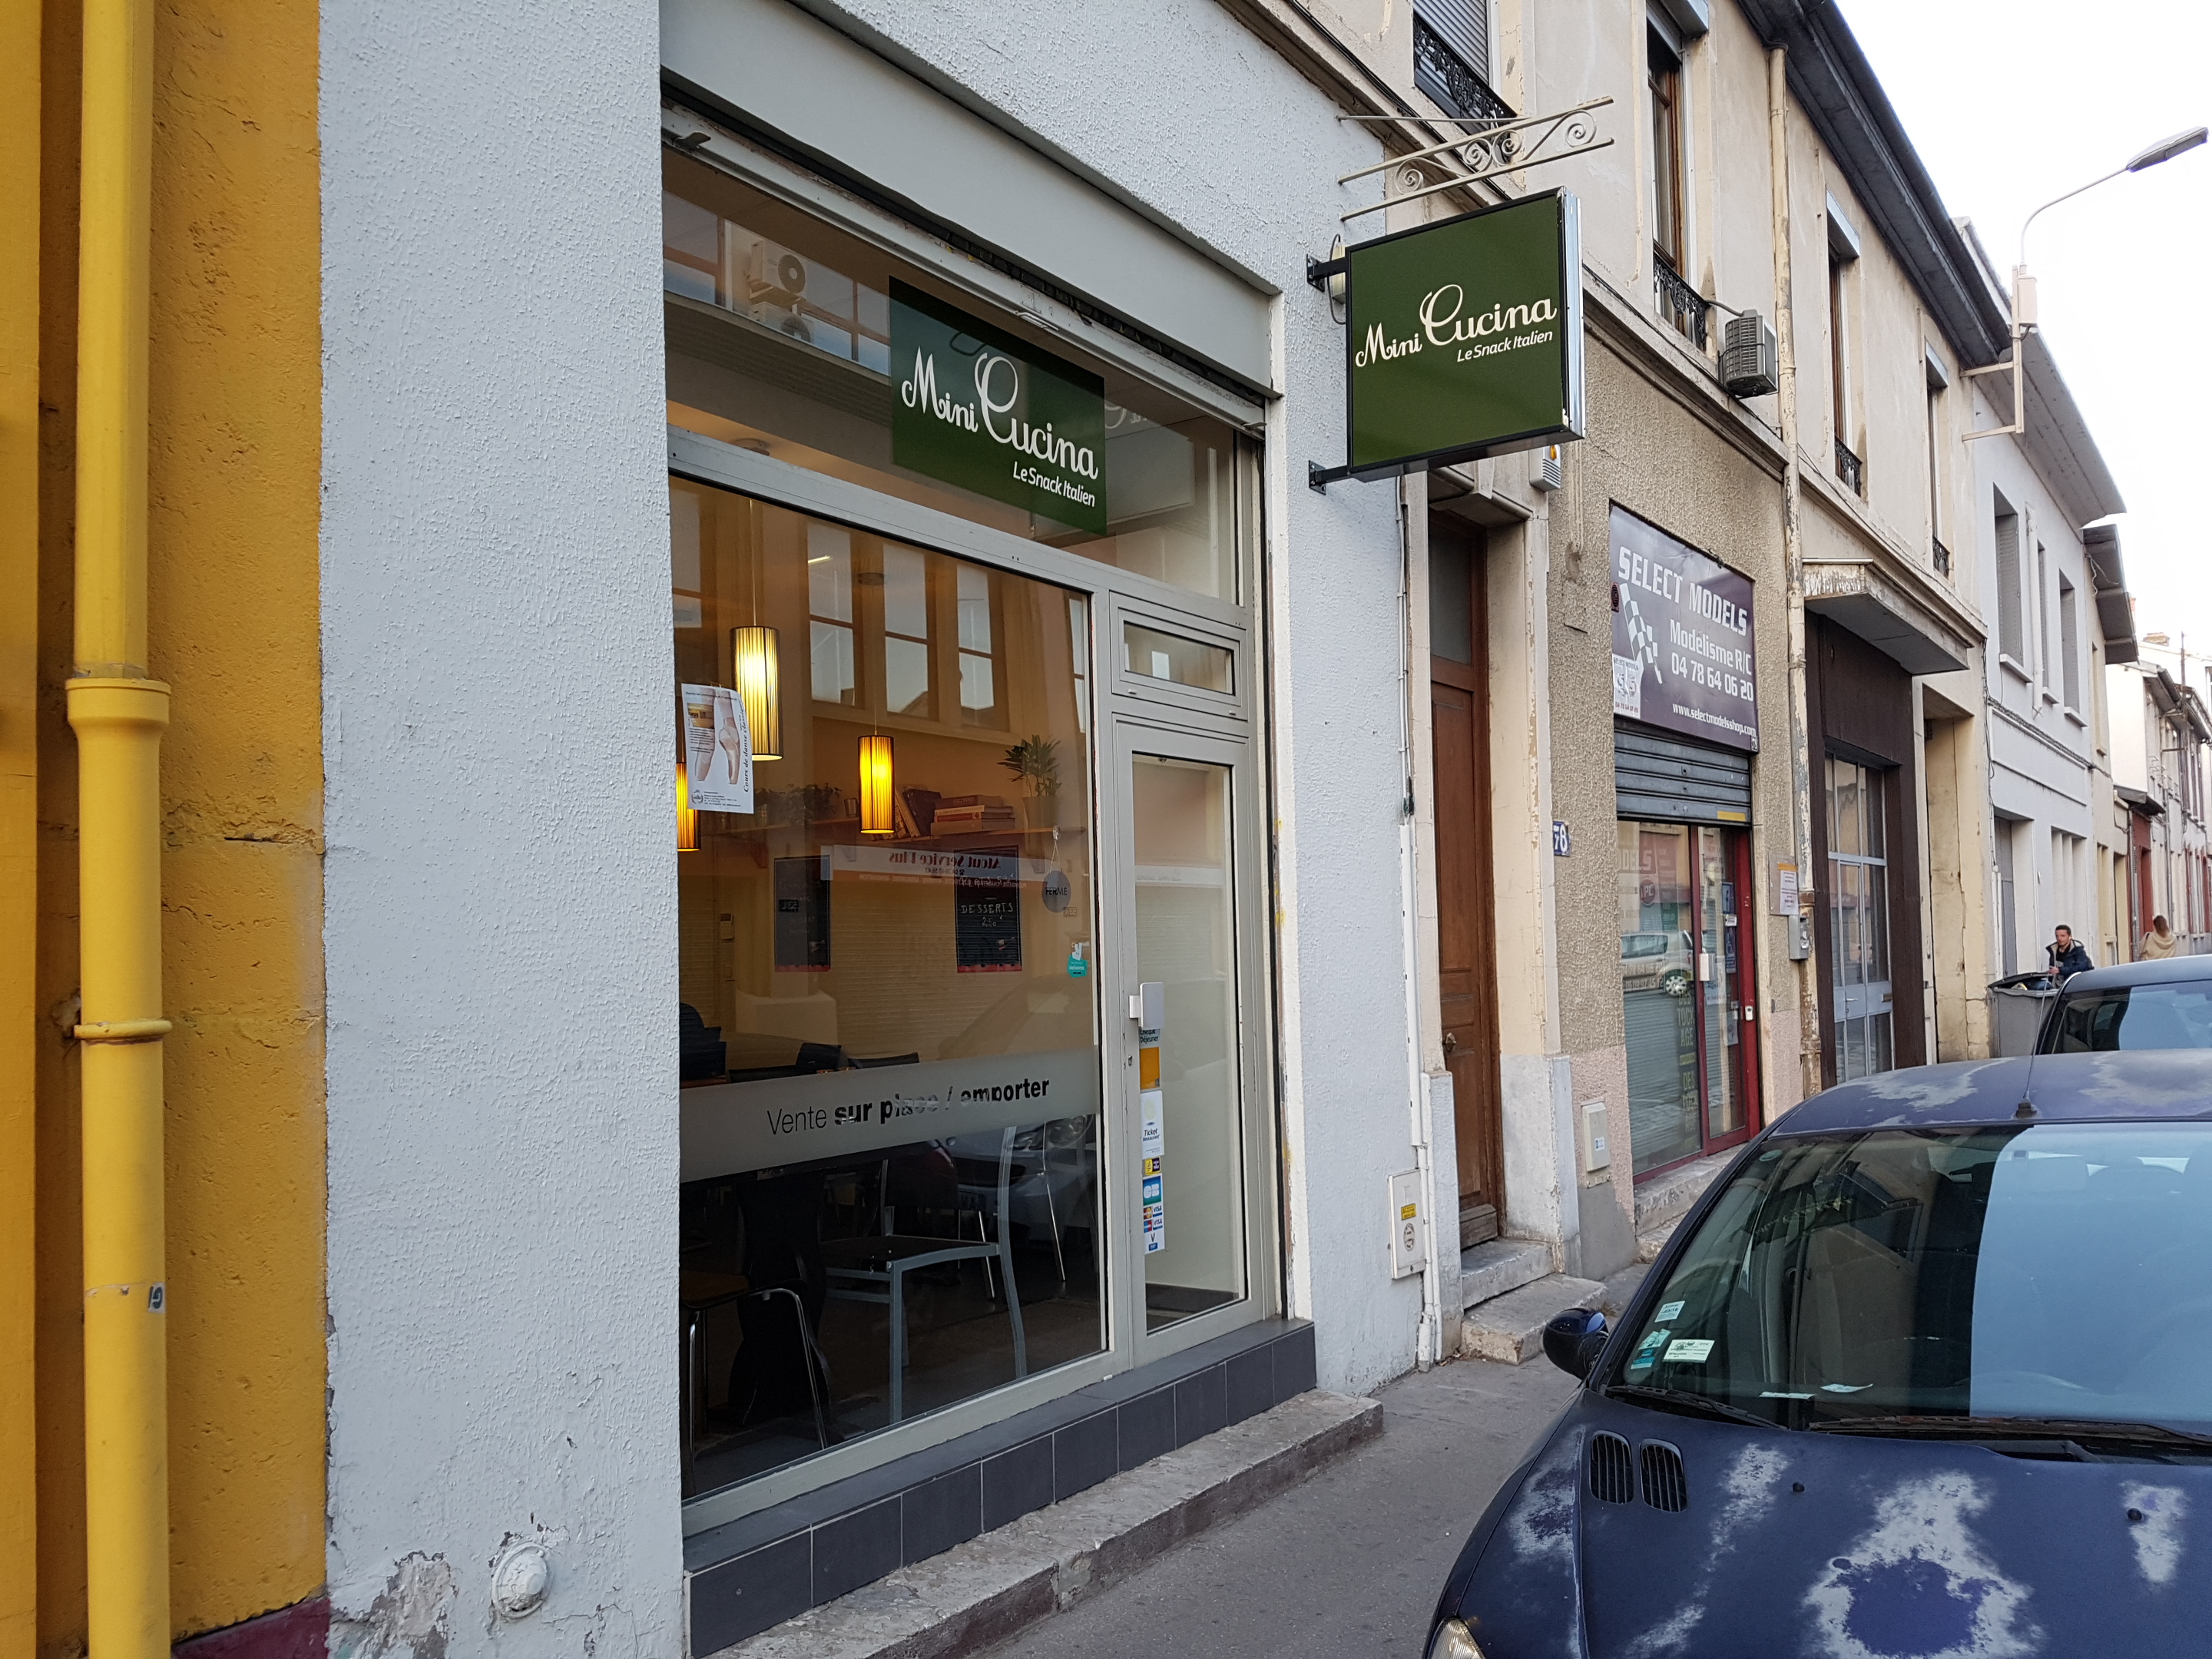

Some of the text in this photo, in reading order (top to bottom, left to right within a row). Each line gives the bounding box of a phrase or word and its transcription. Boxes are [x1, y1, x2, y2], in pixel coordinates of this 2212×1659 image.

[1355, 284, 1557, 367] Mini Cucina
[1457, 329, 1552, 363] Le Snack Italien
[902, 346, 1098, 479] Mini Cucina
[1013, 462, 1095, 507] Le Snack Italien
[1618, 546, 1683, 604] SELECT
[1689, 581, 1747, 637] MODELS
[1671, 652, 1753, 702] 04 78 64 06 20
[1735, 648, 1752, 676] R/C
[1673, 703, 1757, 738] www.selectmodelsshop.com
[743, 759, 749, 768] de
[961, 902, 1014, 915] DESSERTS
[767, 1105, 827, 1136] Vente
[834, 1102, 873, 1126] sur
[960, 1078, 1051, 1104] emporter
[1144, 1128, 1158, 1137] Ticket
[1154, 1218, 1163, 1227] VISA
